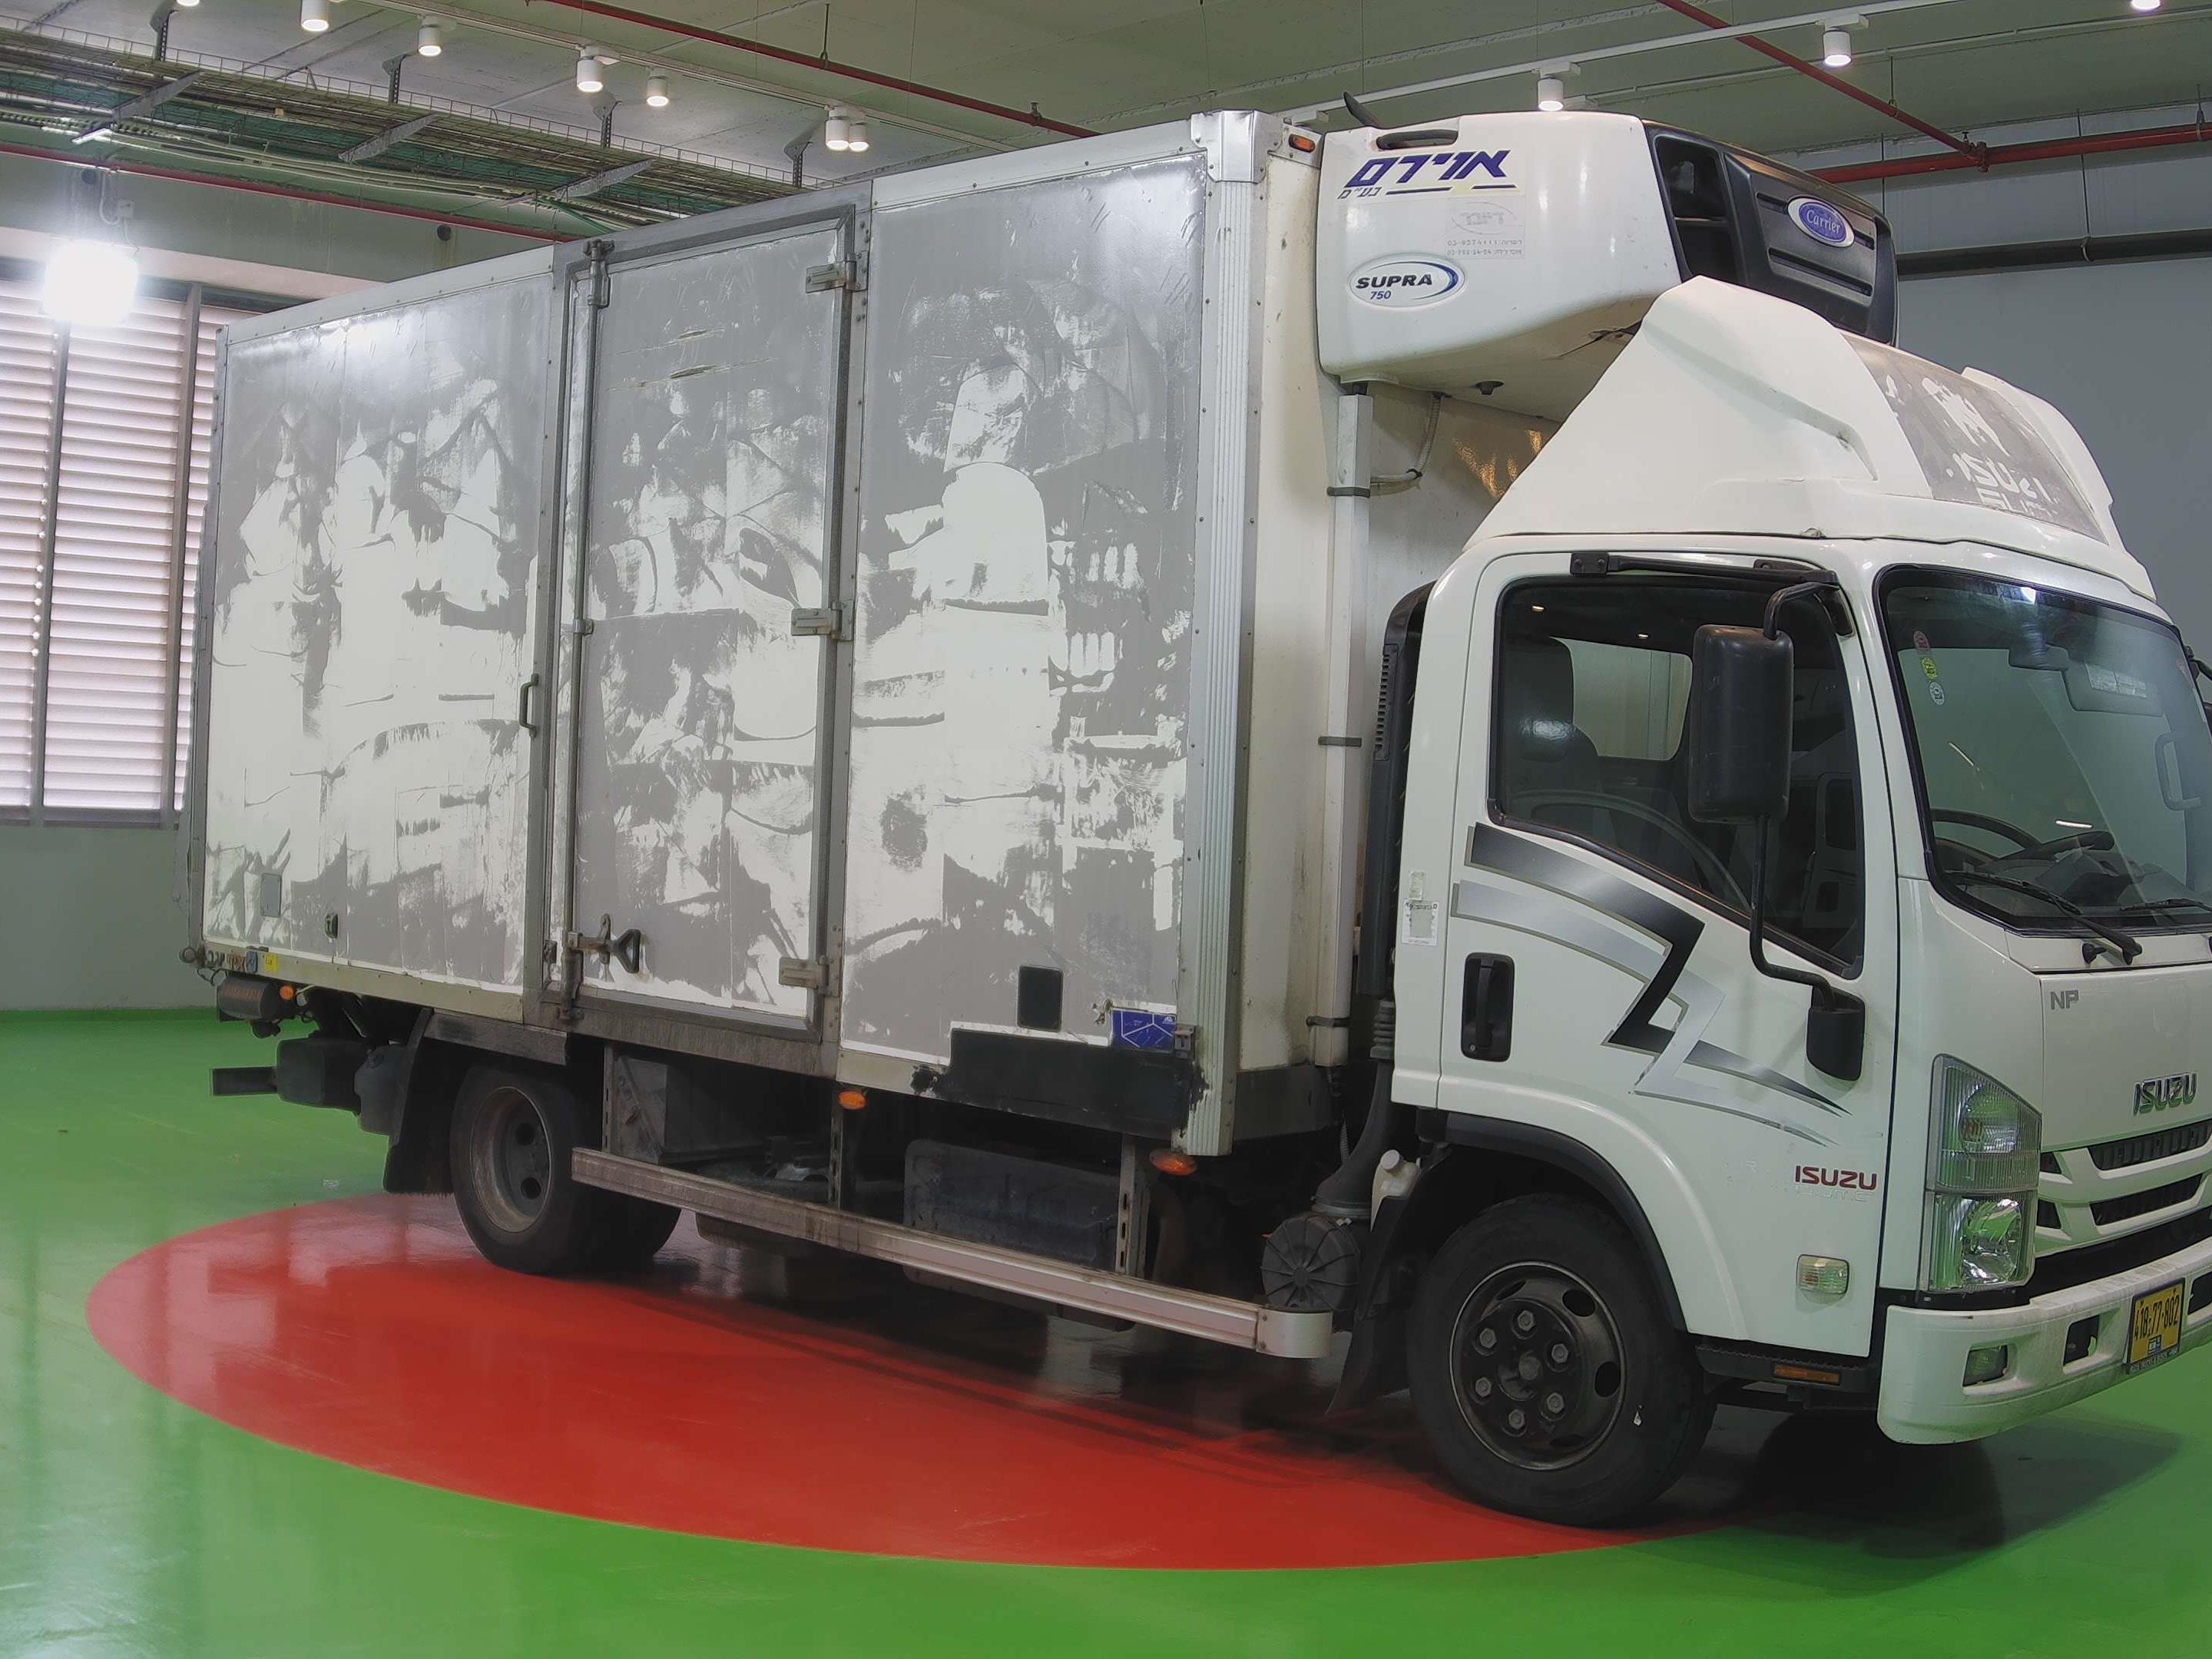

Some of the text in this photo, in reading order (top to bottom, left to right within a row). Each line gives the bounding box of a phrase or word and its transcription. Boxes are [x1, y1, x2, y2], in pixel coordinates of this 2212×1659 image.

[1806, 209, 1840, 234] Carrier
[1355, 273, 1433, 289] SUPRA
[1369, 290, 1392, 300] 750
[2049, 989, 2080, 1011] NP
[2133, 1073, 2198, 1117] ISUZU
[1795, 1164, 1878, 1190] ISUZU
